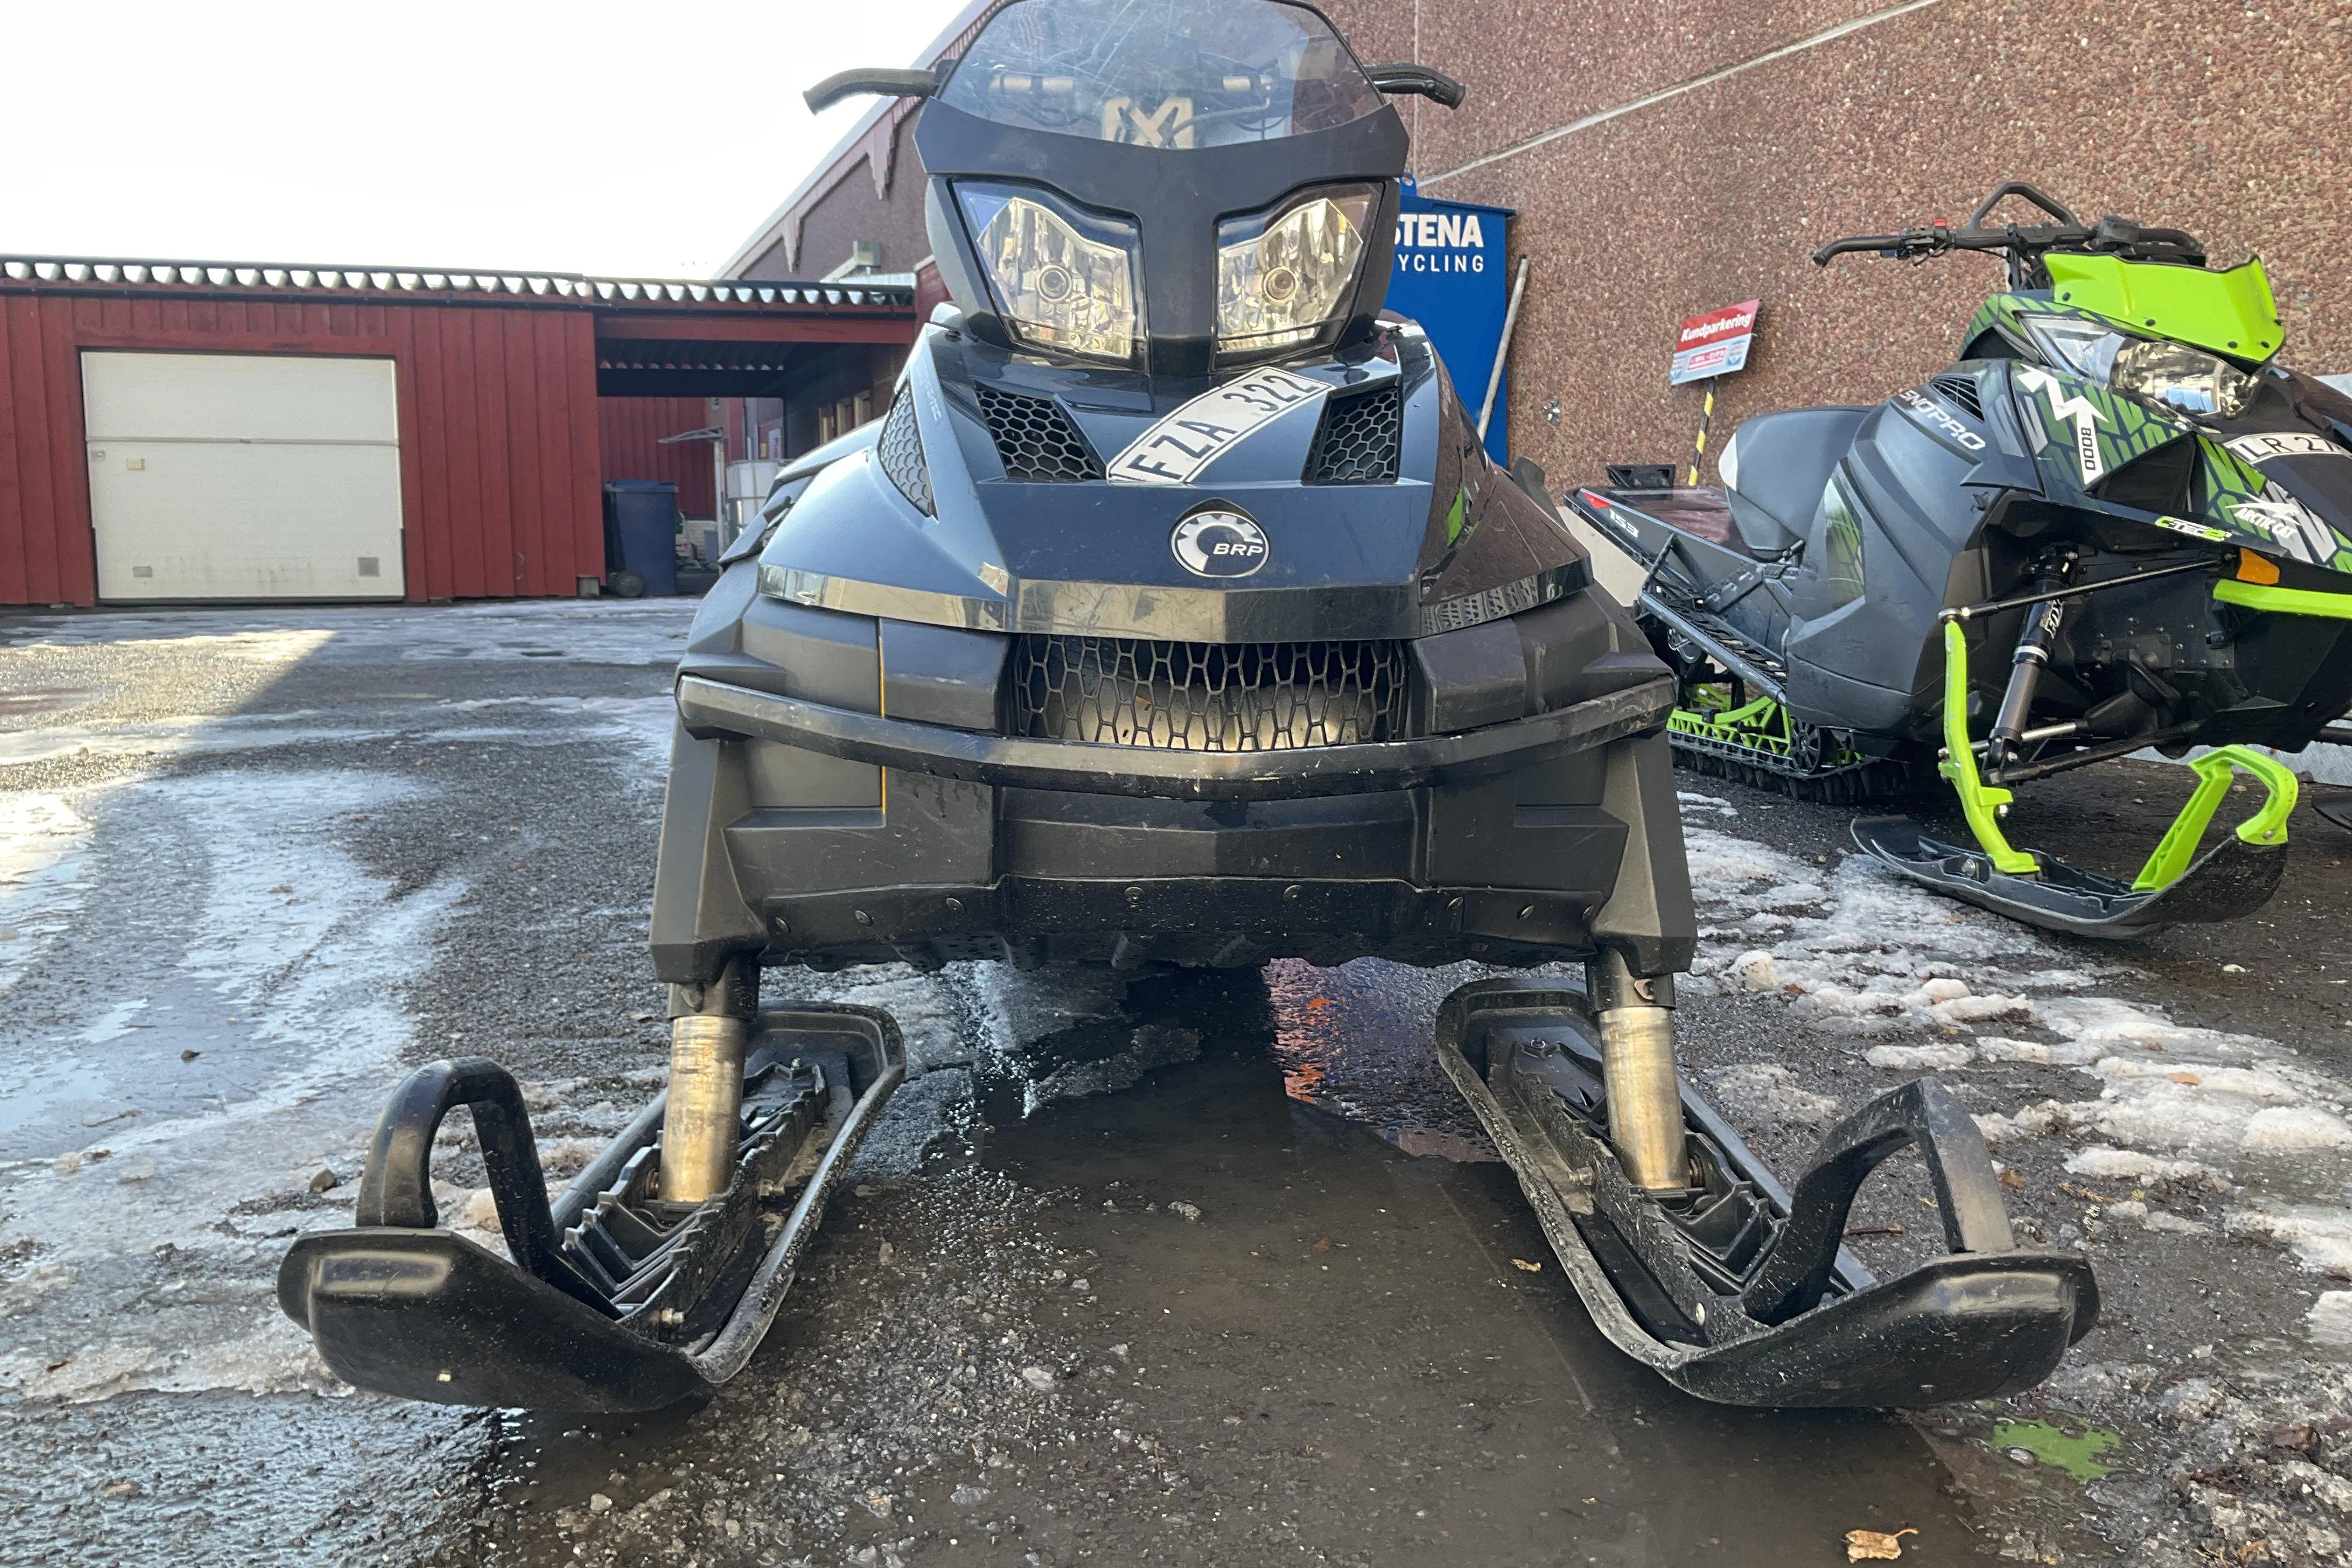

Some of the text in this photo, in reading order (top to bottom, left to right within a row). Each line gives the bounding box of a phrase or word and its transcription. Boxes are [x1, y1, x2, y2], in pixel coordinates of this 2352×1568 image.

[1680, 313, 1752, 342] Kundparkering
[1126, 374, 1318, 480] FZA 322
[1898, 389, 1986, 450] SNOPRO
[2081, 427, 2096, 471] 8000
[1609, 509, 1639, 538] 153
[2234, 508, 2298, 539] ARCTIC CAT
[1213, 543, 1264, 556] BRP
